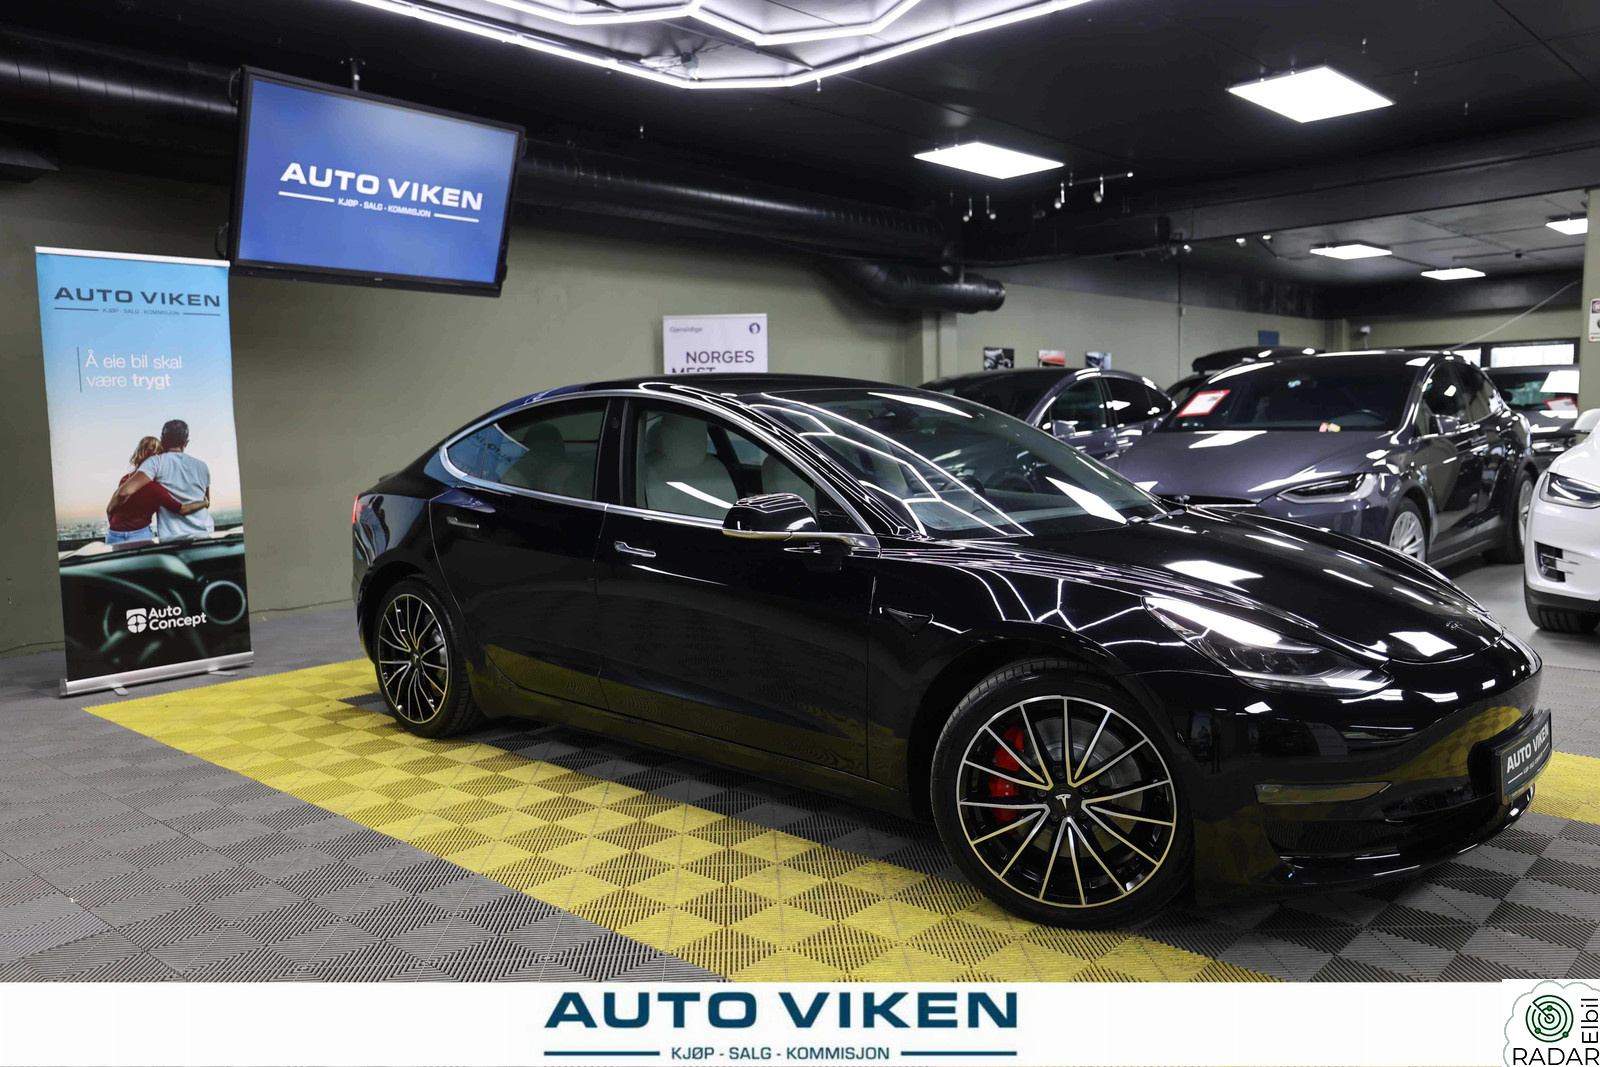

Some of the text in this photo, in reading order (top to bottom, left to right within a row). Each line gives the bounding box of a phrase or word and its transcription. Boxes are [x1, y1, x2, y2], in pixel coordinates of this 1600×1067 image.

[280, 162, 483, 211] AUTO VIKEN
[363, 201, 383, 211] SALG
[388, 205, 431, 218] KOMMISJON
[54, 287, 220, 307] AUTO VIKEN
[85, 349, 183, 369] Å eie bil skal
[686, 350, 755, 364] NORGES
[86, 373, 171, 390] være trygt
[148, 605, 182, 619] Auto
[149, 612, 207, 631] Concept
[1506, 743, 1532, 774] AUTO
[1532, 721, 1549, 753] VIKEN
